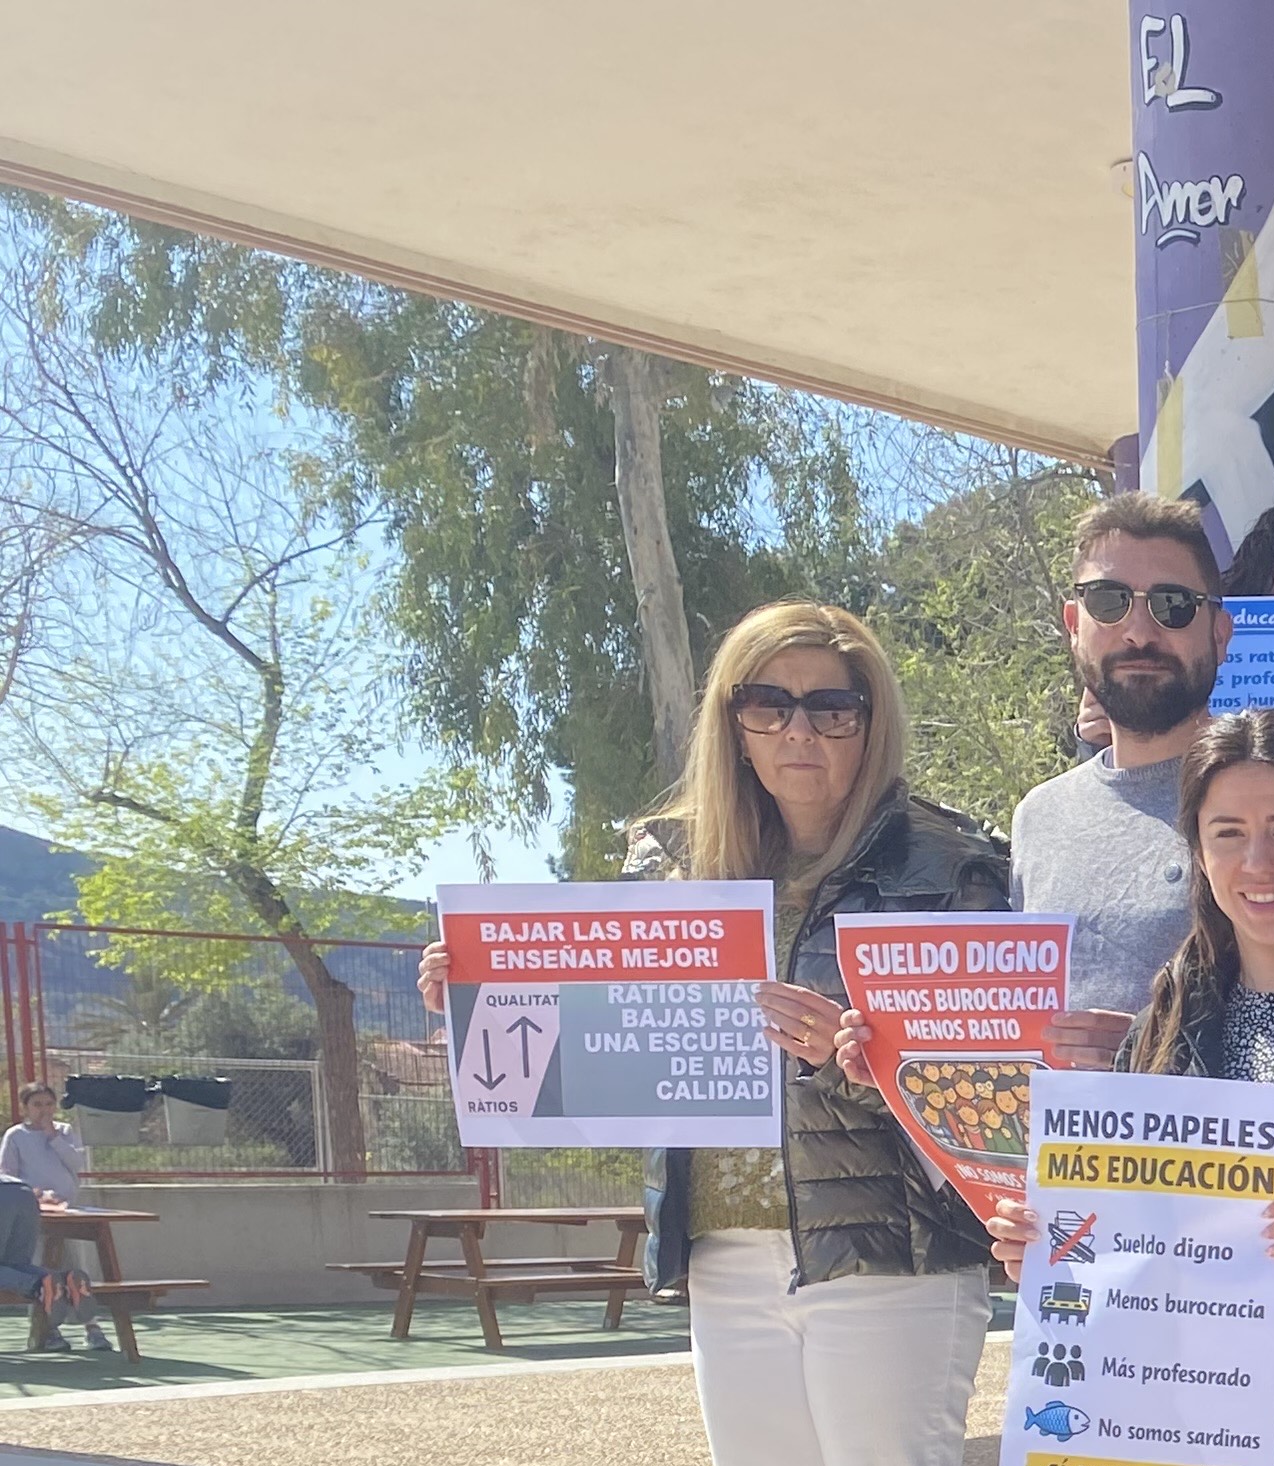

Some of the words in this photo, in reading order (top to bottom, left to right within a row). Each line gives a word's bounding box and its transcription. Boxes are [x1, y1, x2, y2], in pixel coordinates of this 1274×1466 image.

[1140, 13, 1221, 110] EL
[480, 920, 563, 943] BAJAR
[573, 920, 622, 942] LAS
[631, 919, 725, 940] RATIOS
[490, 944, 613, 970] ENSEÑAR
[621, 946, 719, 970] MEJOR!
[855, 941, 959, 977] SUELDO
[966, 940, 1060, 974] DIGNO
[486, 993, 560, 1008] QUALITAT
[608, 984, 703, 1004] RATIOS
[866, 988, 931, 1012] MENOS
[935, 987, 1059, 1011] BUROCRACIA
[622, 1008, 706, 1028] BAJAS
[715, 1007, 768, 1028] POR
[903, 1018, 965, 1041] MENOS
[970, 1018, 1021, 1040] RATIO
[584, 1033, 640, 1053] UNA
[648, 1032, 769, 1052] ESCUELA
[671, 1056, 705, 1077] DE
[713, 1050, 769, 1076] MÁS
[656, 1079, 770, 1101] CALIDAD
[468, 1098, 518, 1114] RÀTIOS
[1043, 1108, 1135, 1140] MENOS
[1047, 1146, 1100, 1184] MÁS
[977, 1168, 1023, 1188] SOMOS
[1113, 1233, 1166, 1256] Sueldo
[1173, 1236, 1234, 1266] digno
[1106, 1289, 1158, 1313] Menos
[1165, 1287, 1265, 1320] burocracia
[1101, 1356, 1136, 1379] Más
[1141, 1358, 1251, 1388] profesorado
[1098, 1418, 1122, 1439] No
[1127, 1424, 1181, 1444] somos
[1186, 1425, 1262, 1450] sardinas
